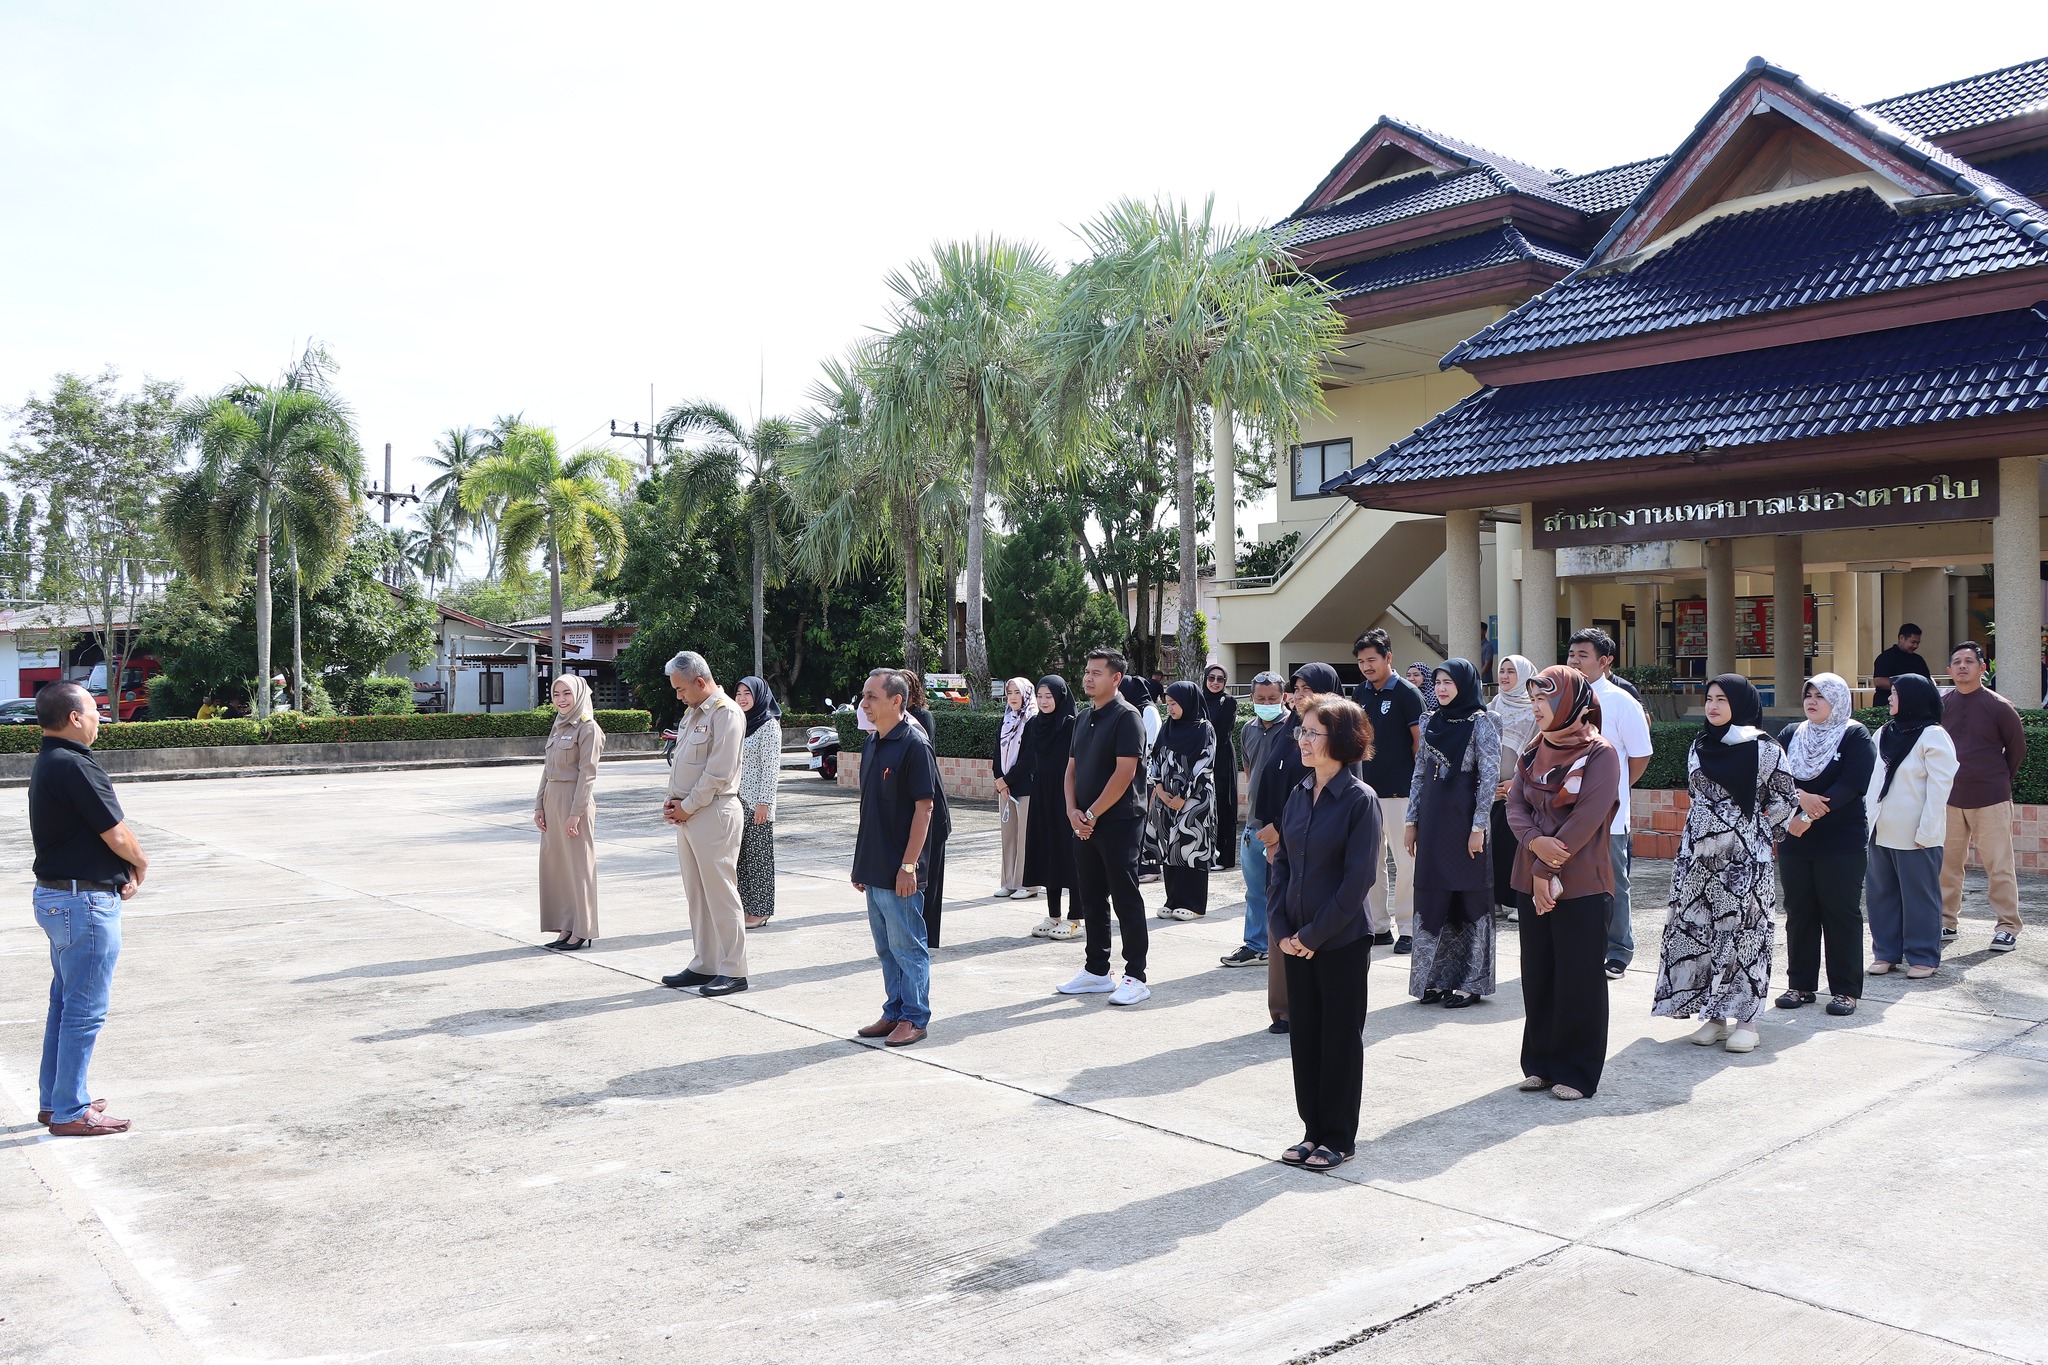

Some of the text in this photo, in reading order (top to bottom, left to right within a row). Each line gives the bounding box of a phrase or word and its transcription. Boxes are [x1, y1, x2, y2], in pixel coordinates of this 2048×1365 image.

[1543, 474, 1979, 532] สำนักงานเทศบาลเมืองตากใบ
